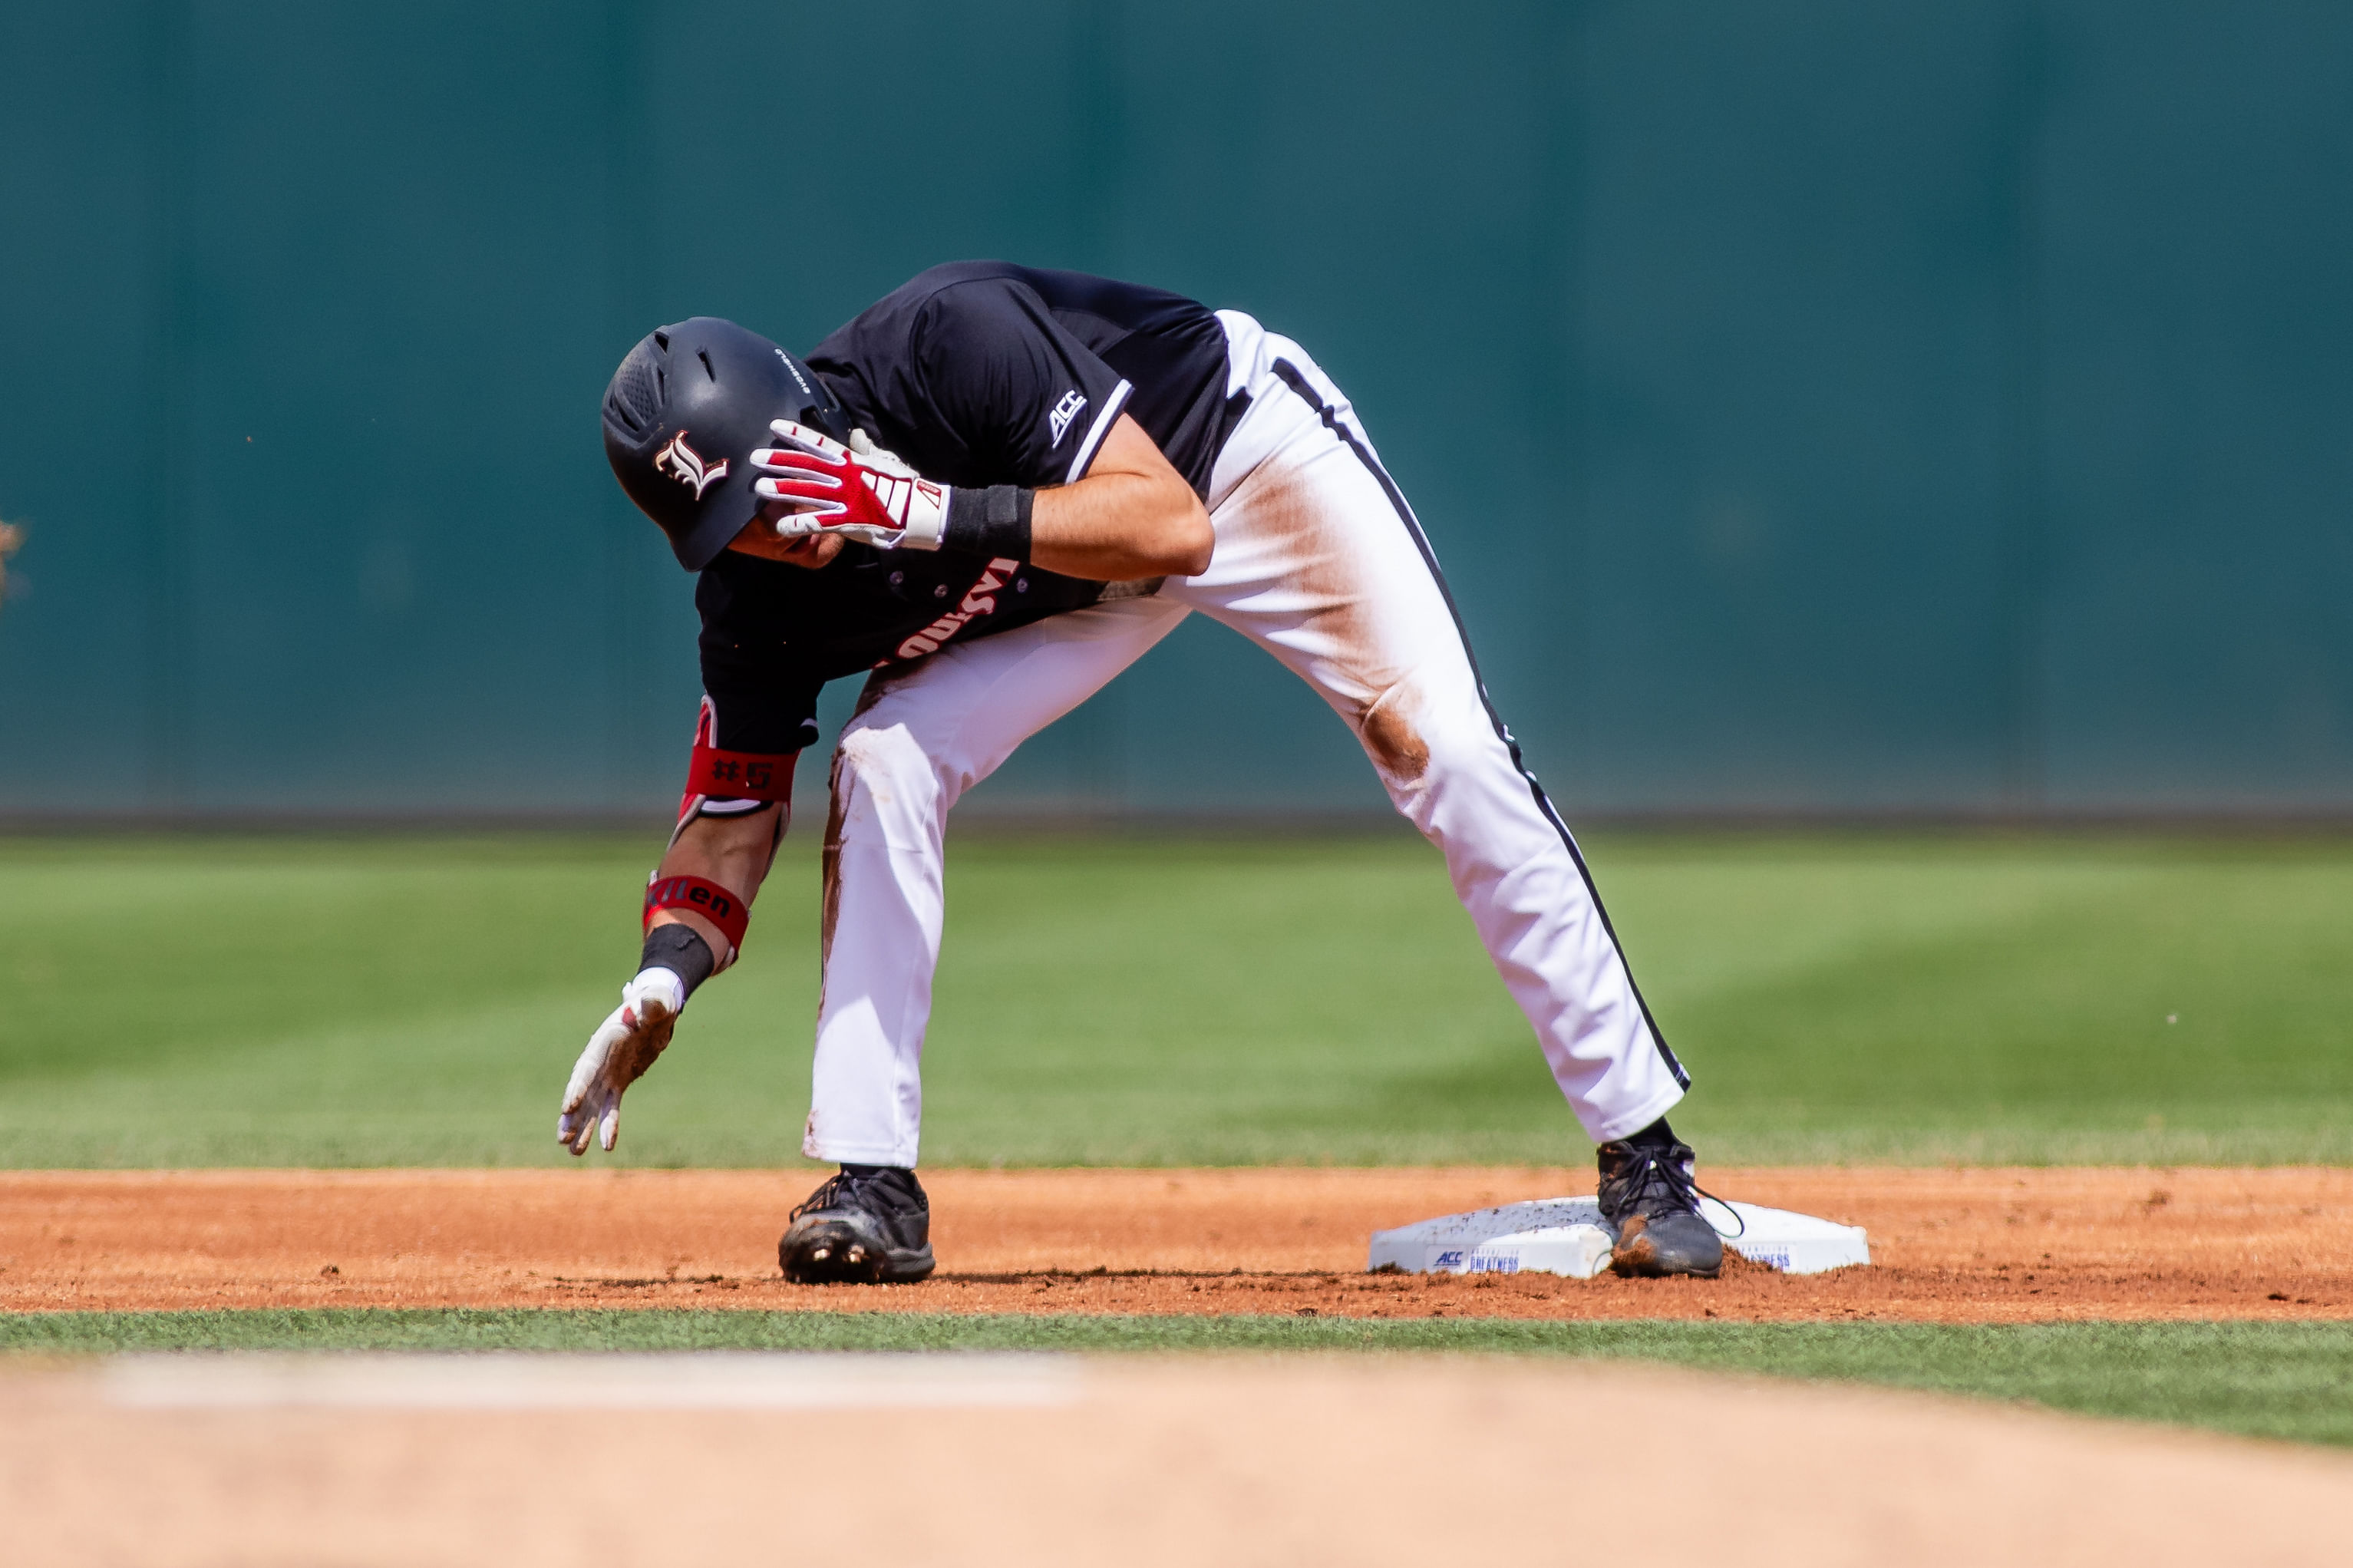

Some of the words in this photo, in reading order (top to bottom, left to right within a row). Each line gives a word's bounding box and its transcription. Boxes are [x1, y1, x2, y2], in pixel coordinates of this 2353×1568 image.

[1048, 389, 1087, 448] ACC
[652, 429, 730, 502] L
[712, 758, 773, 789] #5
[1434, 1251, 1464, 1266] ACC
